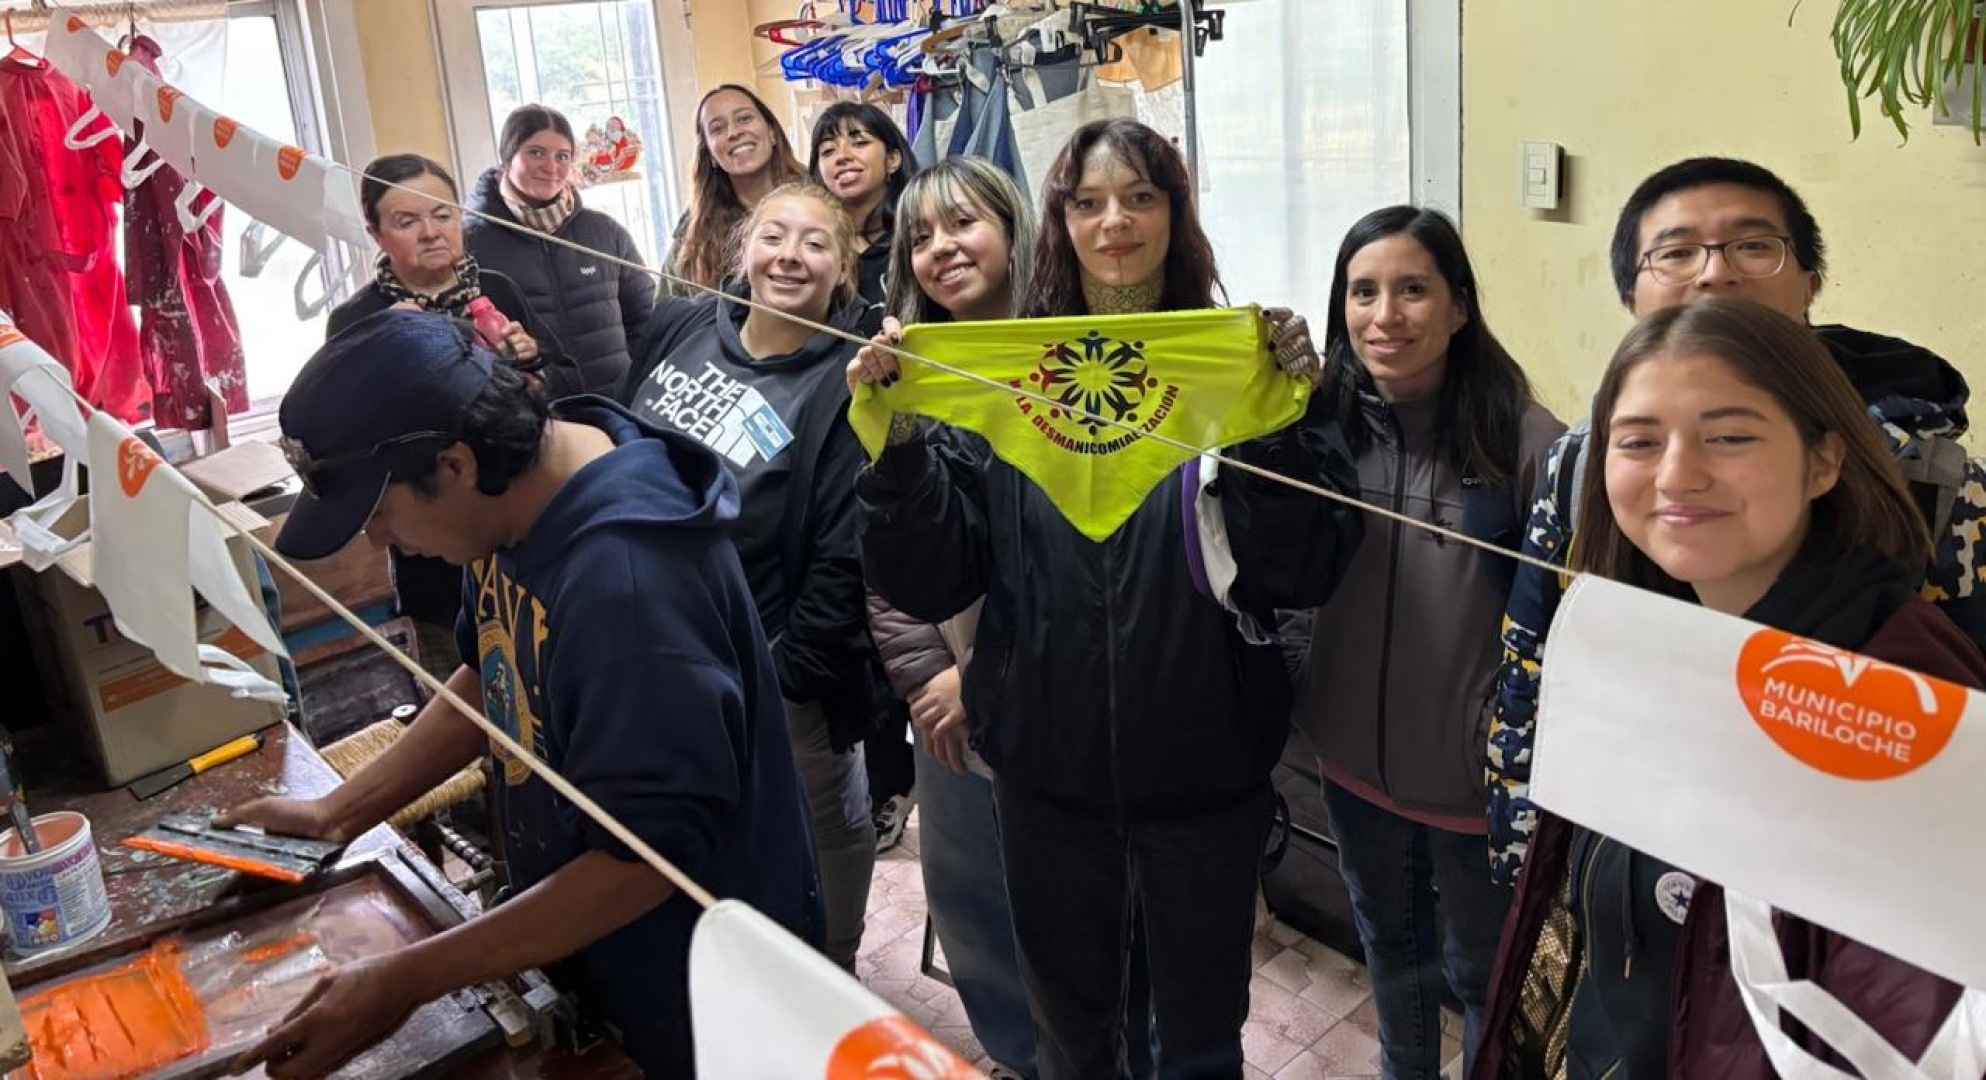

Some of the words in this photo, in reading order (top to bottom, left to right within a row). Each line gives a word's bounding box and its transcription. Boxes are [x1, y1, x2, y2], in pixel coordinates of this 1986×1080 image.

[649, 359, 735, 422] NORTH
[698, 360, 748, 403] THE
[652, 391, 718, 441] FACE
[1032, 384, 1180, 455] DESMANICOMIALZACIÓN
[1760, 699, 1912, 763] BARILOCHE
[1763, 677, 1917, 741] MUNICIPIO
